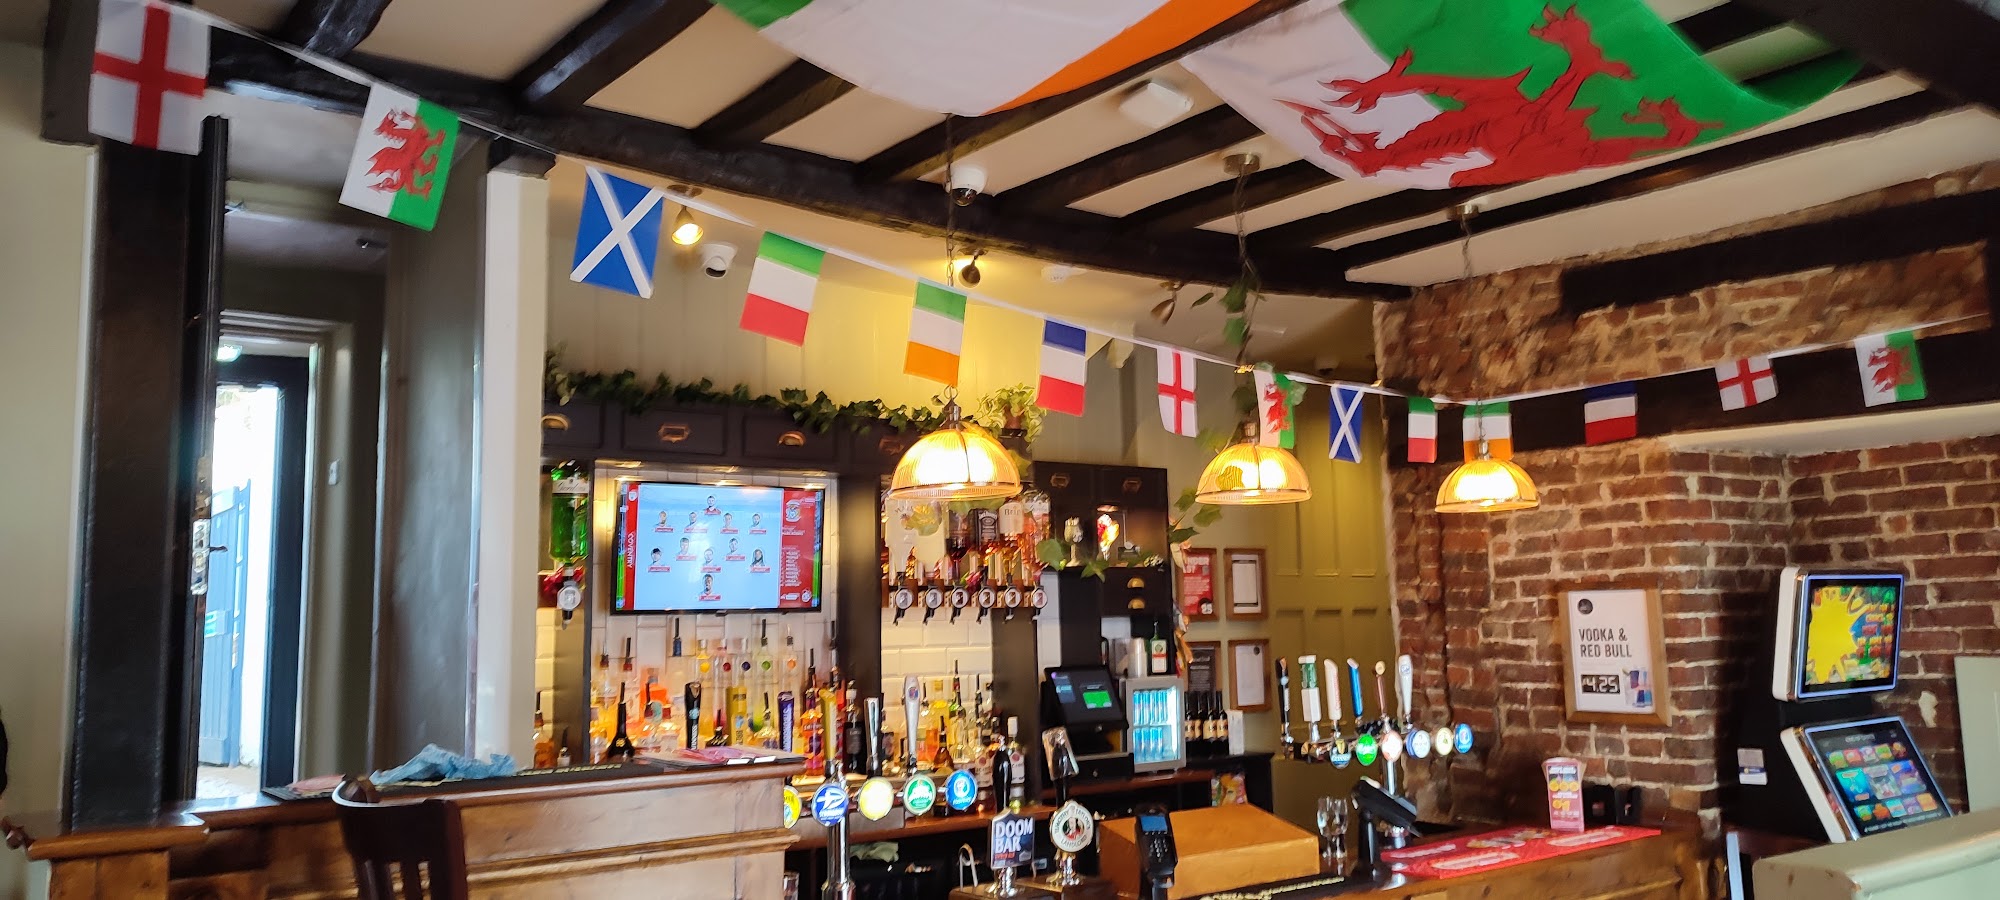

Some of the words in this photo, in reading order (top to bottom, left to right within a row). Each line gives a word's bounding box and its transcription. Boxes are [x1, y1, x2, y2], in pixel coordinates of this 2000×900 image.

[1578, 628, 1614, 641] VODKA
[1618, 627, 1628, 641] &
[1580, 644, 1601, 658] RED
[1604, 644, 1632, 658] BULL
[995, 817, 1034, 838] DOOM
[995, 837, 1021, 853] BAR
